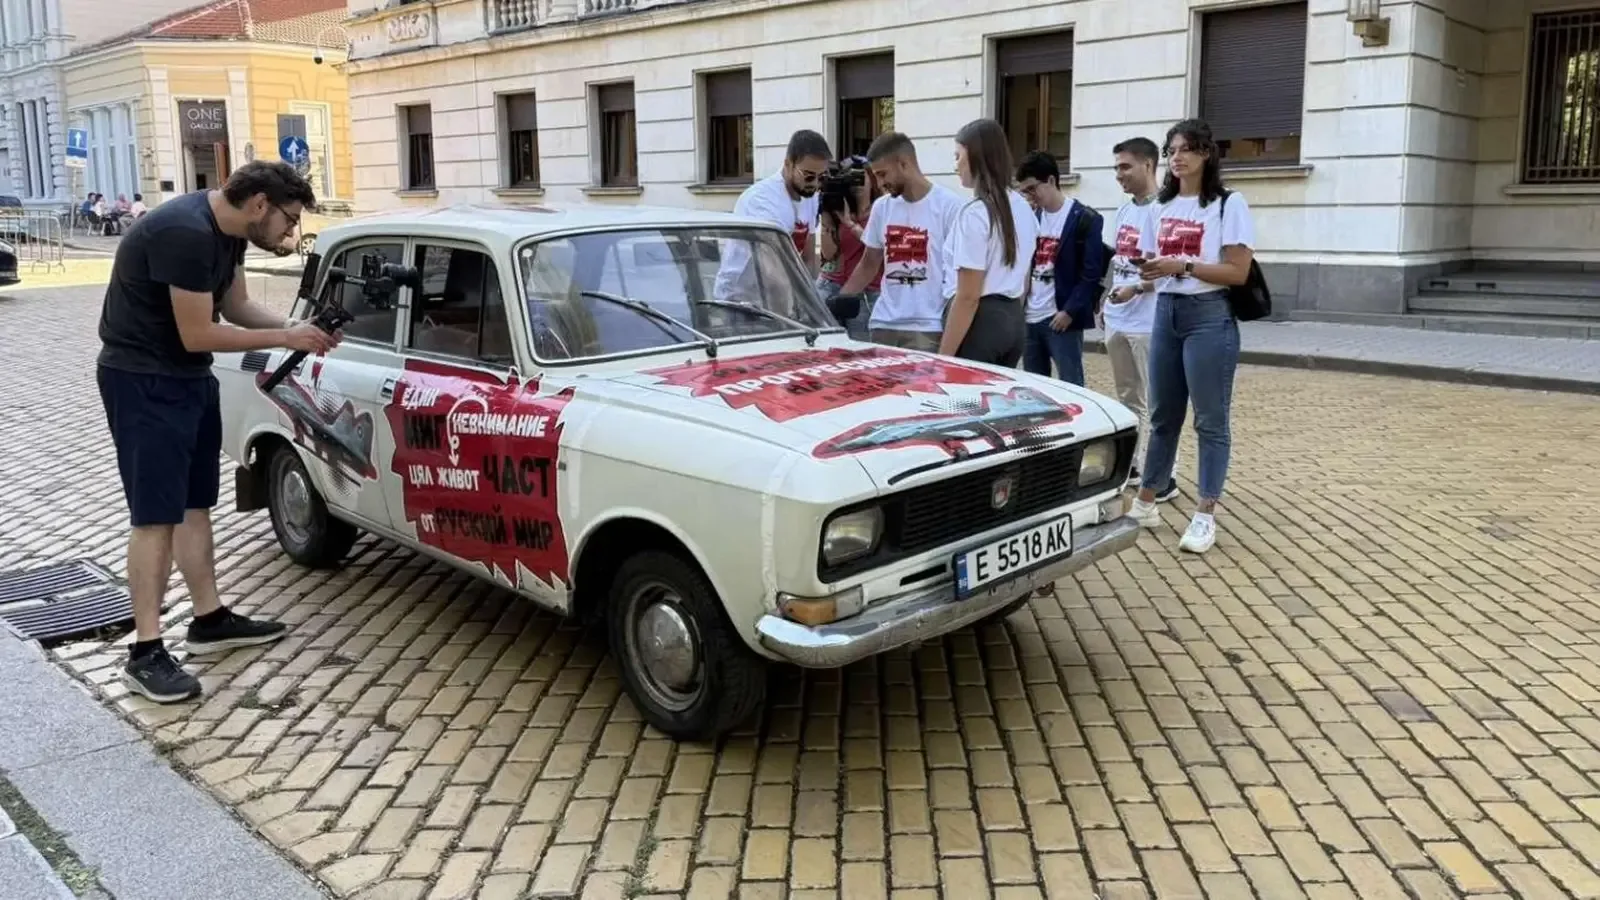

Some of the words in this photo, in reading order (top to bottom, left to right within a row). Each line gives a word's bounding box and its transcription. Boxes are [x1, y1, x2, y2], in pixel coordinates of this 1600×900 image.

[187, 107, 223, 121] ONE
[401, 387, 439, 410] ЕДИН
[405, 414, 445, 448] МИГ
[452, 413, 549, 437] НЕВНИМАНИЕ
[408, 464, 434, 489] ЦЯЛ
[436, 466, 480, 491] ЖИВОТ
[482, 454, 551, 497] ЧАСТ
[420, 513, 435, 533] ОТ
[512, 518, 553, 549] МИР
[998, 530, 1042, 571] 5518
